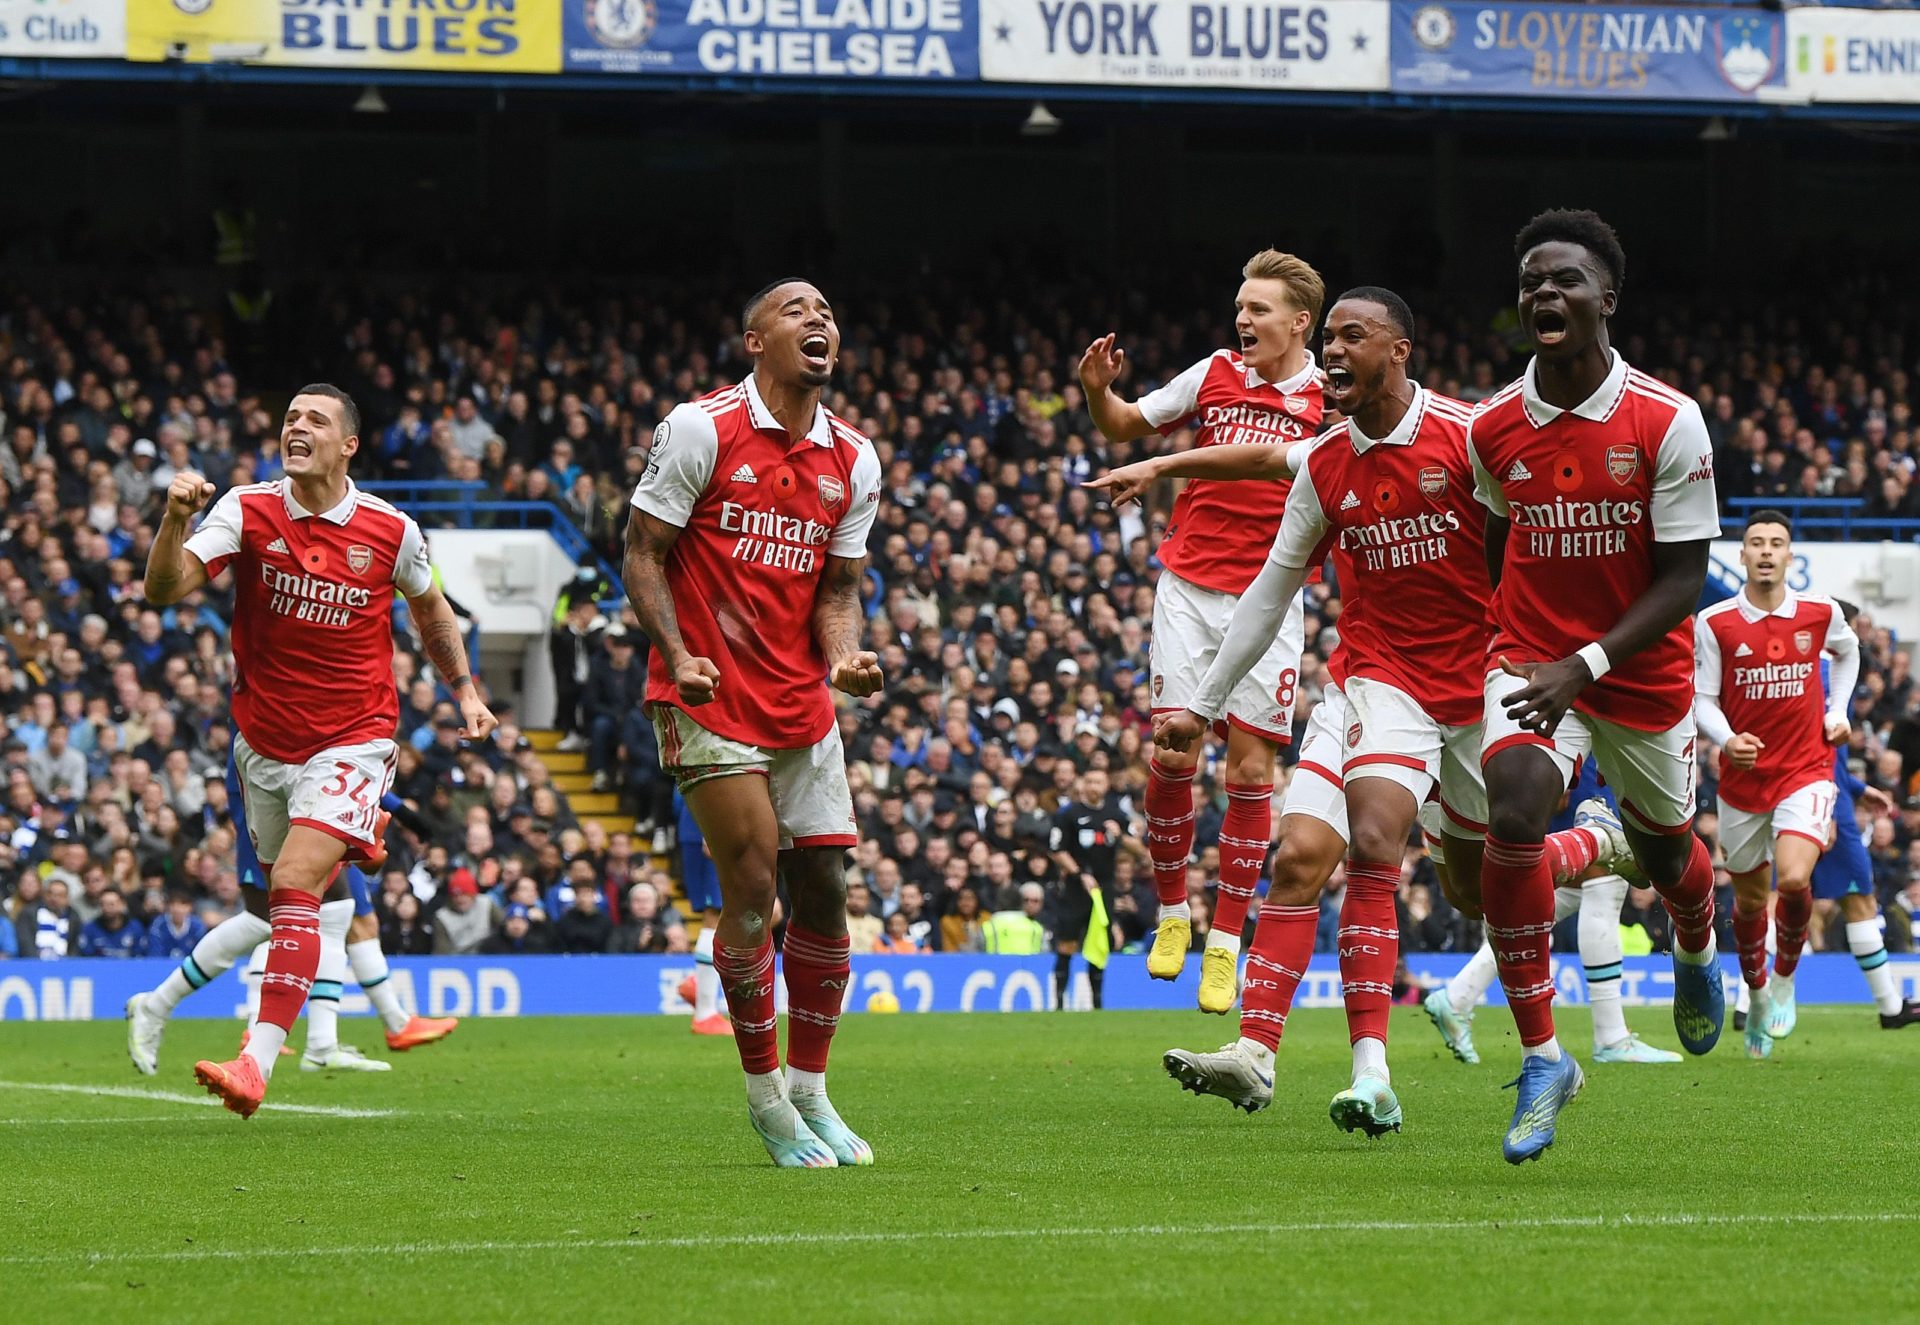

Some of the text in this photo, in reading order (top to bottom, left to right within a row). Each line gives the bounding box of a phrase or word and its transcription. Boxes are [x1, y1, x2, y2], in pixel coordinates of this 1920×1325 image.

[25, 16, 98, 41] Club
[283, 14, 520, 56] BLUES
[1039, 1, 1329, 62] YORK BLUES
[1473, 10, 1706, 54] SLOVENIAN
[698, 29, 956, 77] CHELSEA
[1530, 50, 1650, 90] BLUES
[1204, 403, 1304, 438] Emirates
[720, 501, 832, 546] Emirates
[1340, 510, 1460, 550] Emirates
[1508, 496, 1644, 529] Emirates
[732, 537, 815, 573] FLY BETTER
[1365, 537, 1448, 571] FLY BETTER
[1530, 529, 1626, 557] FLY BETTER
[261, 562, 371, 607] Emirates
[270, 594, 352, 627] FLY BETTER
[1276, 667, 1297, 708] 8
[1734, 661, 1814, 686] Emirates
[1745, 680, 1805, 700] FLY BETTER
[321, 761, 371, 813] 34
[1811, 792, 1829, 821] 11
[1339, 945, 1380, 958] AFC
[1498, 949, 1538, 962] AFC
[1244, 978, 1278, 990] AFC
